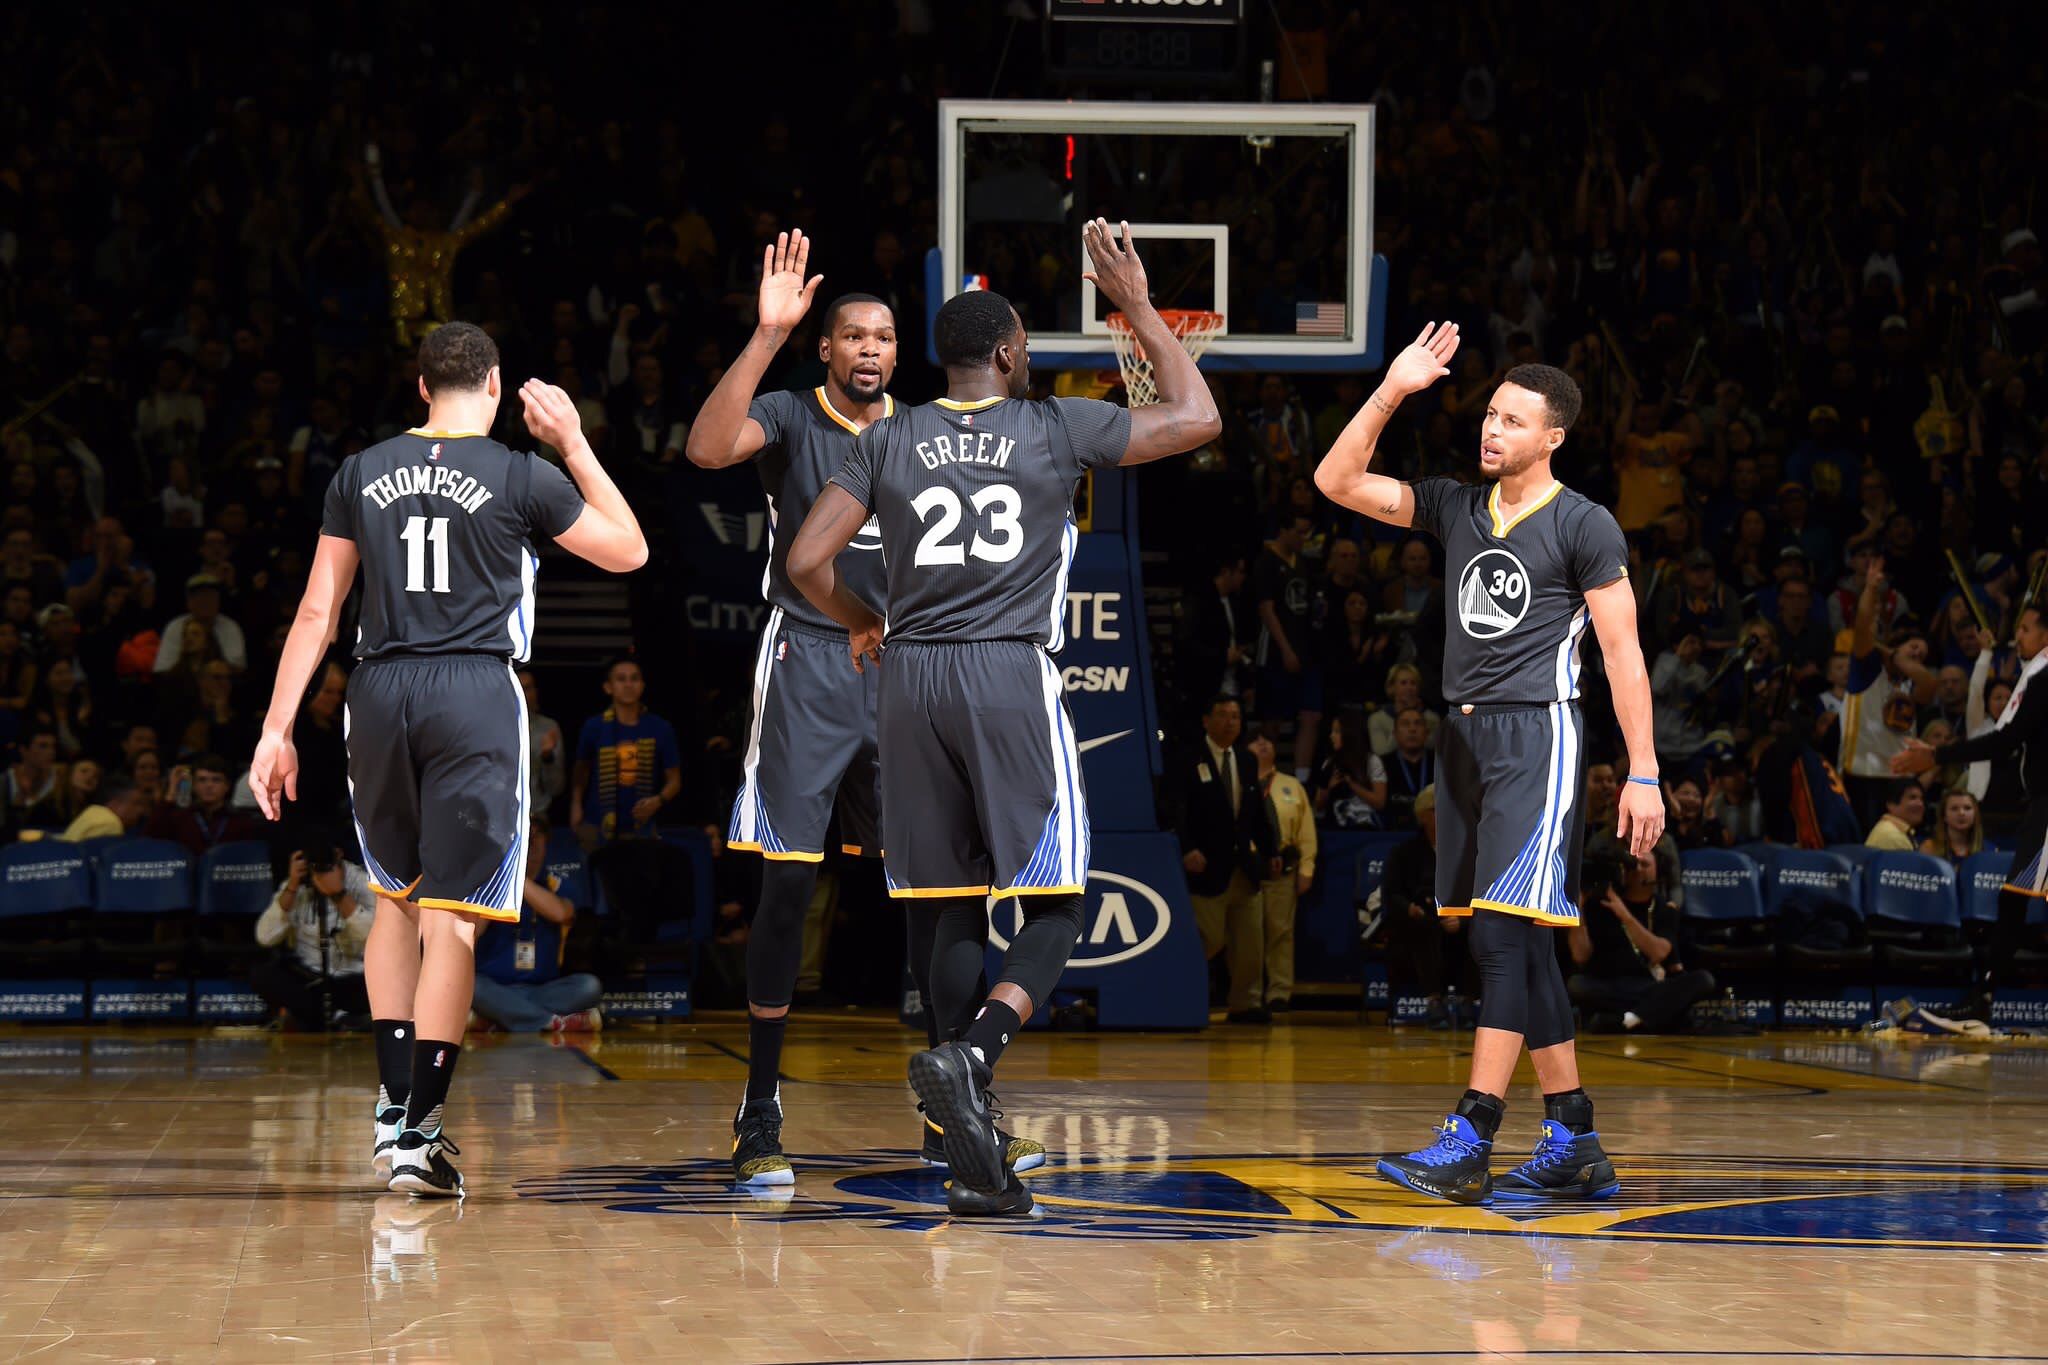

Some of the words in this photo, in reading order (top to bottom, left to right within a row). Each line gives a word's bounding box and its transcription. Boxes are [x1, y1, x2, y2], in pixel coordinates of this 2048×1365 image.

[916, 432, 1016, 471] GREEN
[361, 465, 494, 516] THOMPSON
[910, 484, 1024, 568] 23
[400, 515, 451, 593] 11
[1488, 569, 1524, 600] 30
[1061, 666, 1130, 692] CSN
[7, 859, 83, 874] AMERICAN
[112, 860, 187, 871] AMERICAN
[7, 867, 71, 883] EXPRESS
[111, 869, 175, 880] EXPRESS
[1681, 869, 1751, 879] AMERICAN
[1779, 869, 1849, 882] AMERICAN
[1880, 869, 1952, 886] AMERICAN
[1681, 877, 1740, 888] EXPRESS
[1778, 876, 1838, 888] EXPRESS
[1880, 875, 1939, 892] EXPRESS
[0, 993, 83, 1004] MERICAN
[94, 993, 188, 1004] AMERICAN
[602, 991, 688, 1000] AMERICAN
[0, 1003, 67, 1015] XPRESS
[93, 1002, 171, 1014] EXPRESS
[1784, 1000, 1871, 1011] AMERICAN
[1991, 1000, 2048, 1010] MERIC
[1783, 1008, 1857, 1020] EXPRESS
